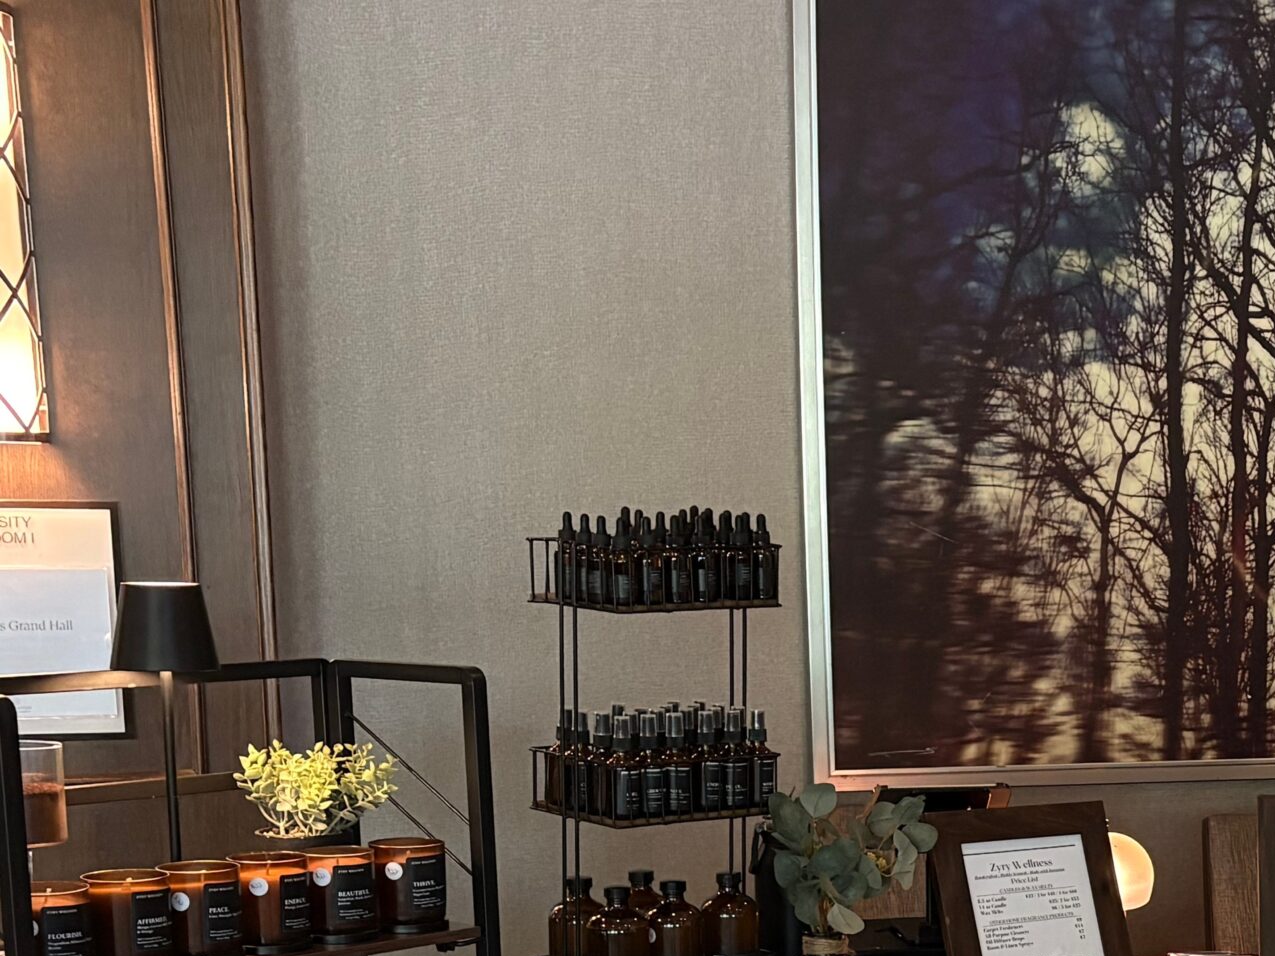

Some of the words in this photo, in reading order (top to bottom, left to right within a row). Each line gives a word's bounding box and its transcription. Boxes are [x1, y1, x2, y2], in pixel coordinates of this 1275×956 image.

[8, 620, 46, 631] Grand
[49, 619, 73, 631] Hall
[991, 862, 1010, 872] Zyry
[1012, 859, 1053, 870] Wellness
